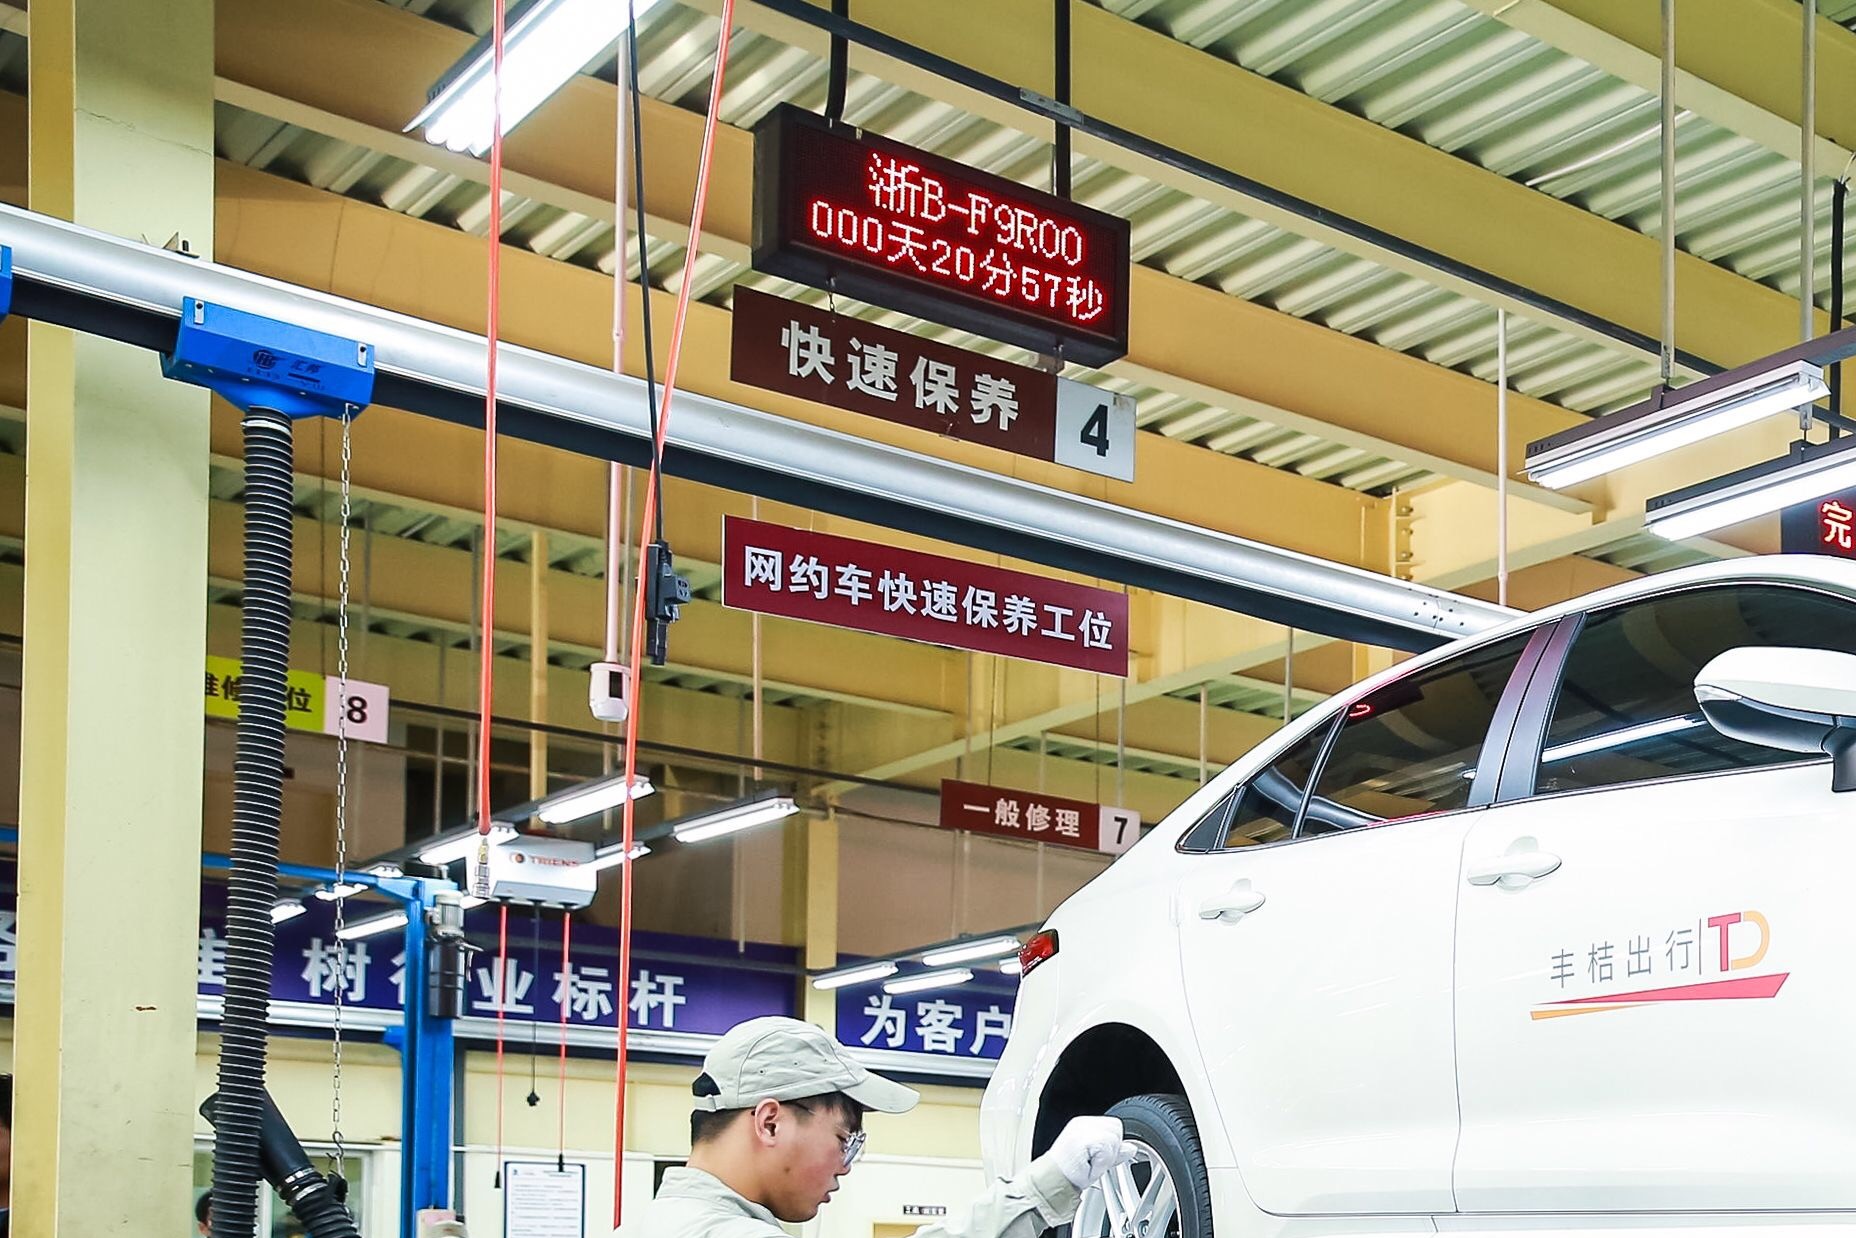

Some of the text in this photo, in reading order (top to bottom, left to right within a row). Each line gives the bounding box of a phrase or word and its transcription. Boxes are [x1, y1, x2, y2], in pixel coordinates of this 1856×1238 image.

[867, 151, 1083, 266] 浙B-F9R00
[811, 200, 1103, 321] 000天20分57秒
[781, 319, 1110, 457] 快速保养 4
[743, 545, 1114, 651] 网约车快速保养工位
[345, 695, 368, 724] 8
[963, 798, 1129, 845] 一般修理 7
[301, 937, 687, 1029] 树业标杆
[1550, 909, 1771, 989] 丰桔出行 TD
[860, 993, 1013, 1055] 为客户
